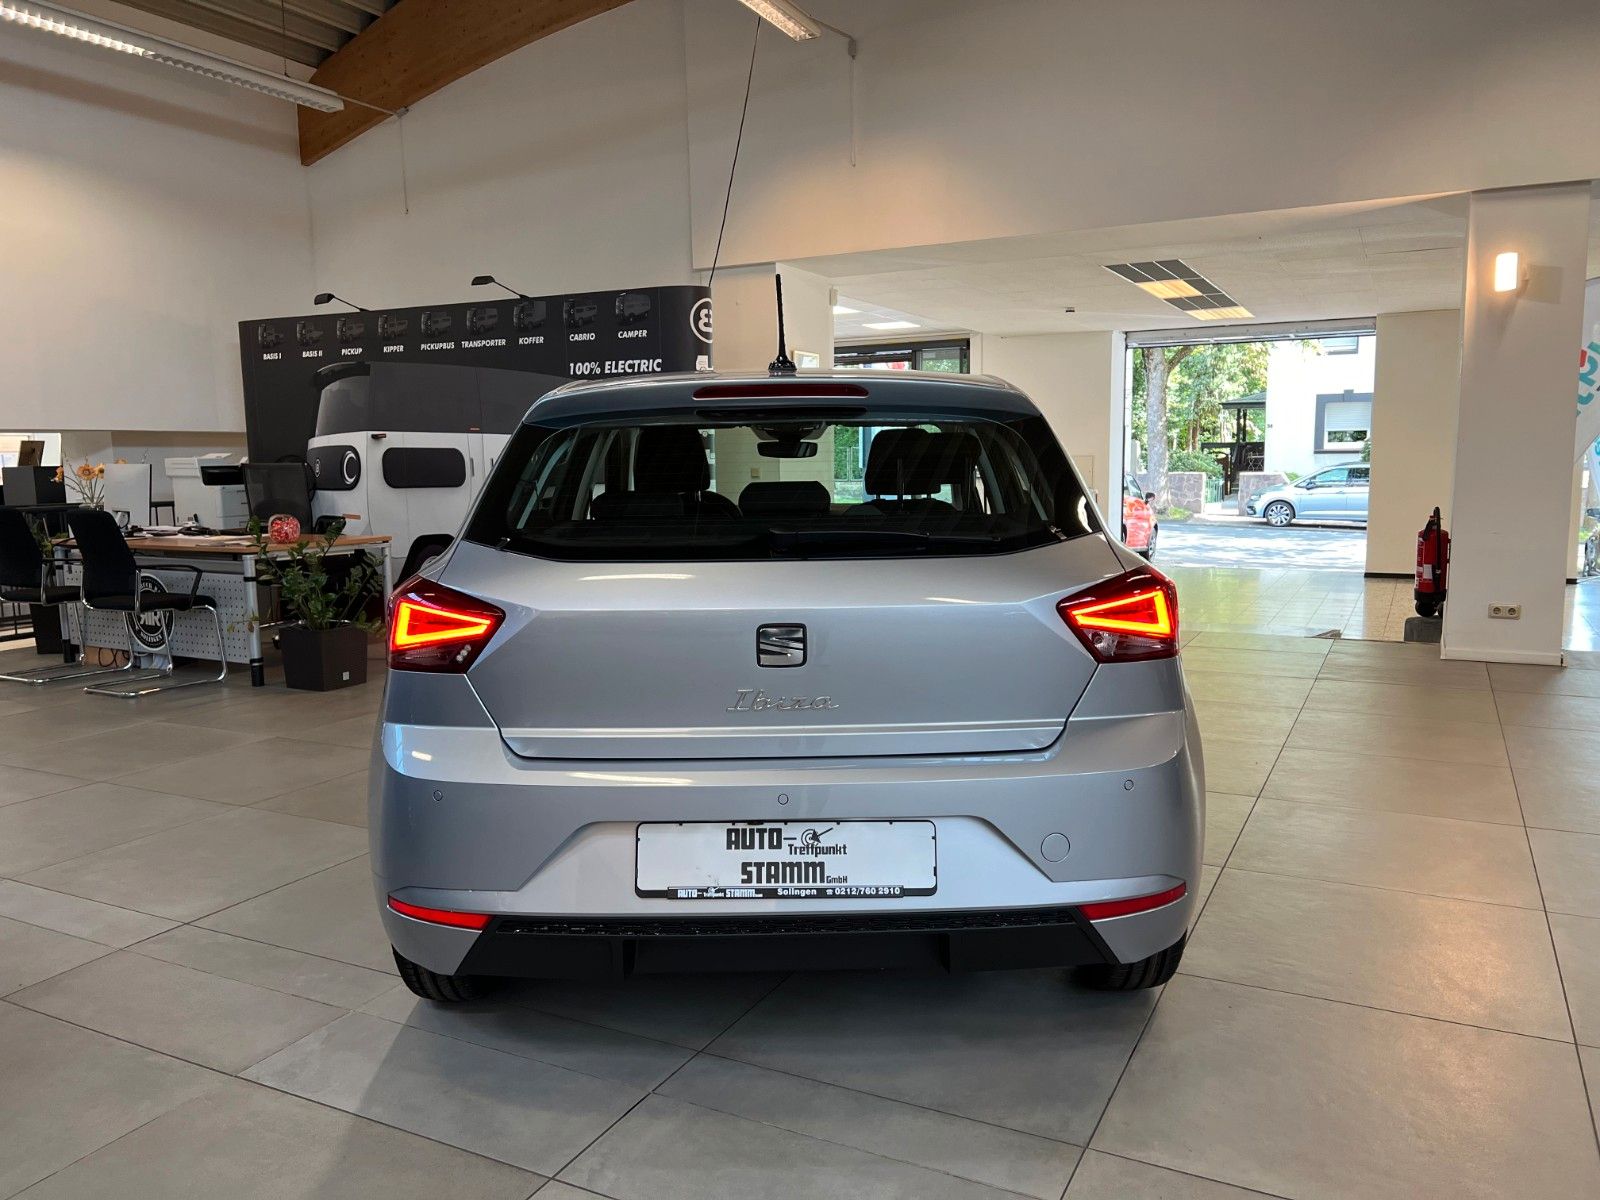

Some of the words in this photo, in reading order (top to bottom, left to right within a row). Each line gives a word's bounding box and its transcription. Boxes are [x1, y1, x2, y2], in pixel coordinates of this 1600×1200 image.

[569, 332, 596, 342] CABRIO
[617, 329, 648, 339] CAMPER
[461, 338, 506, 349] TRANSPORTER
[518, 336, 544, 345] KOFFER
[341, 347, 363, 356] PICKUP
[383, 345, 404, 353] KIPPER
[420, 342, 455, 351] PICKUPBUS
[263, 352, 278, 360] BASIS
[302, 350, 318, 358] BASIS
[569, 361, 601, 375] 100%
[604, 358, 662, 374] ELECTRIC
[726, 689, 840, 712] Ibiza
[787, 843, 848, 858] Treffpunkt
[741, 861, 826, 884] STAMM
[826, 875, 848, 884] GmbH
[777, 888, 818, 897] Solingen
[834, 887, 876, 896] 0212/760
[878, 886, 901, 895] 2910
